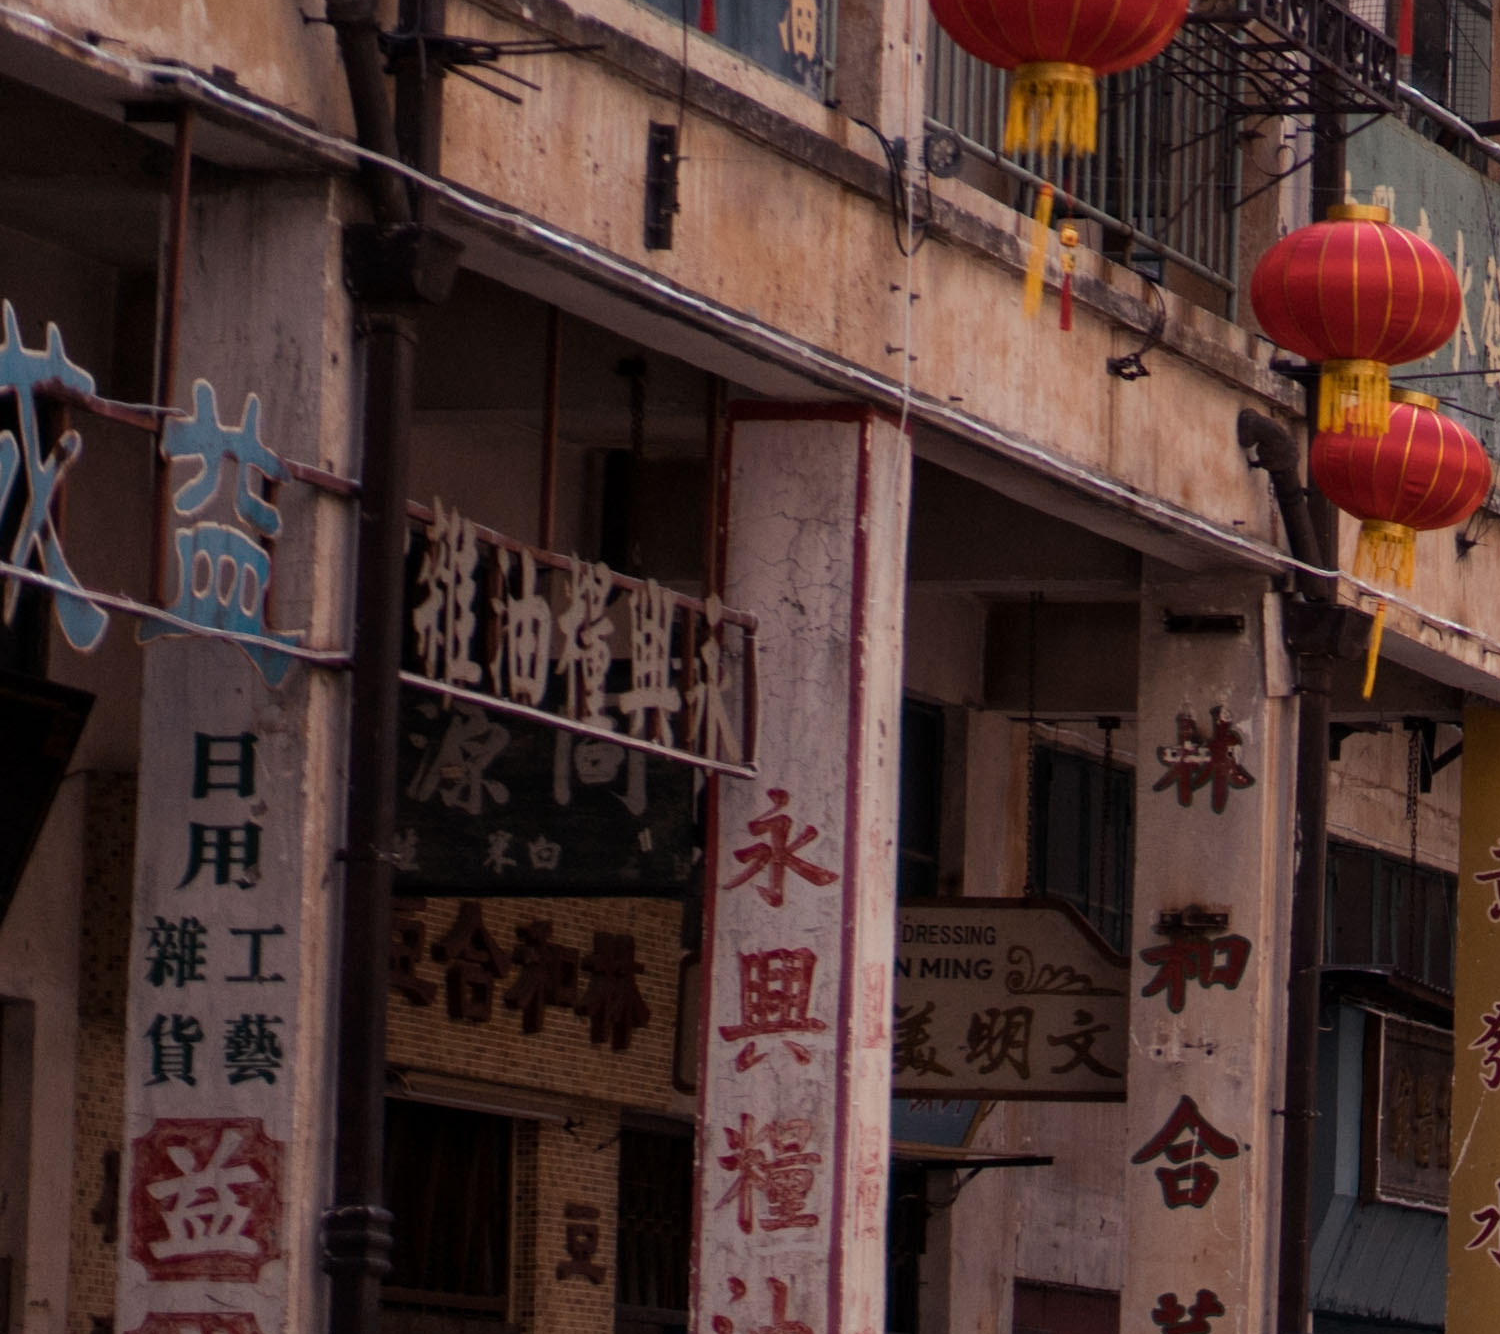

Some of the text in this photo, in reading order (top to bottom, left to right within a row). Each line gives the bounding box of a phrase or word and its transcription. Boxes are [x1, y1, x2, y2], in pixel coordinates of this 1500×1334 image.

[402, 494, 743, 779] 永興糧油雜
[174, 729, 262, 892] 日用
[142, 915, 206, 1089] 雜貨
[223, 921, 287, 1084] 工藝
[919, 957, 994, 981] MING
